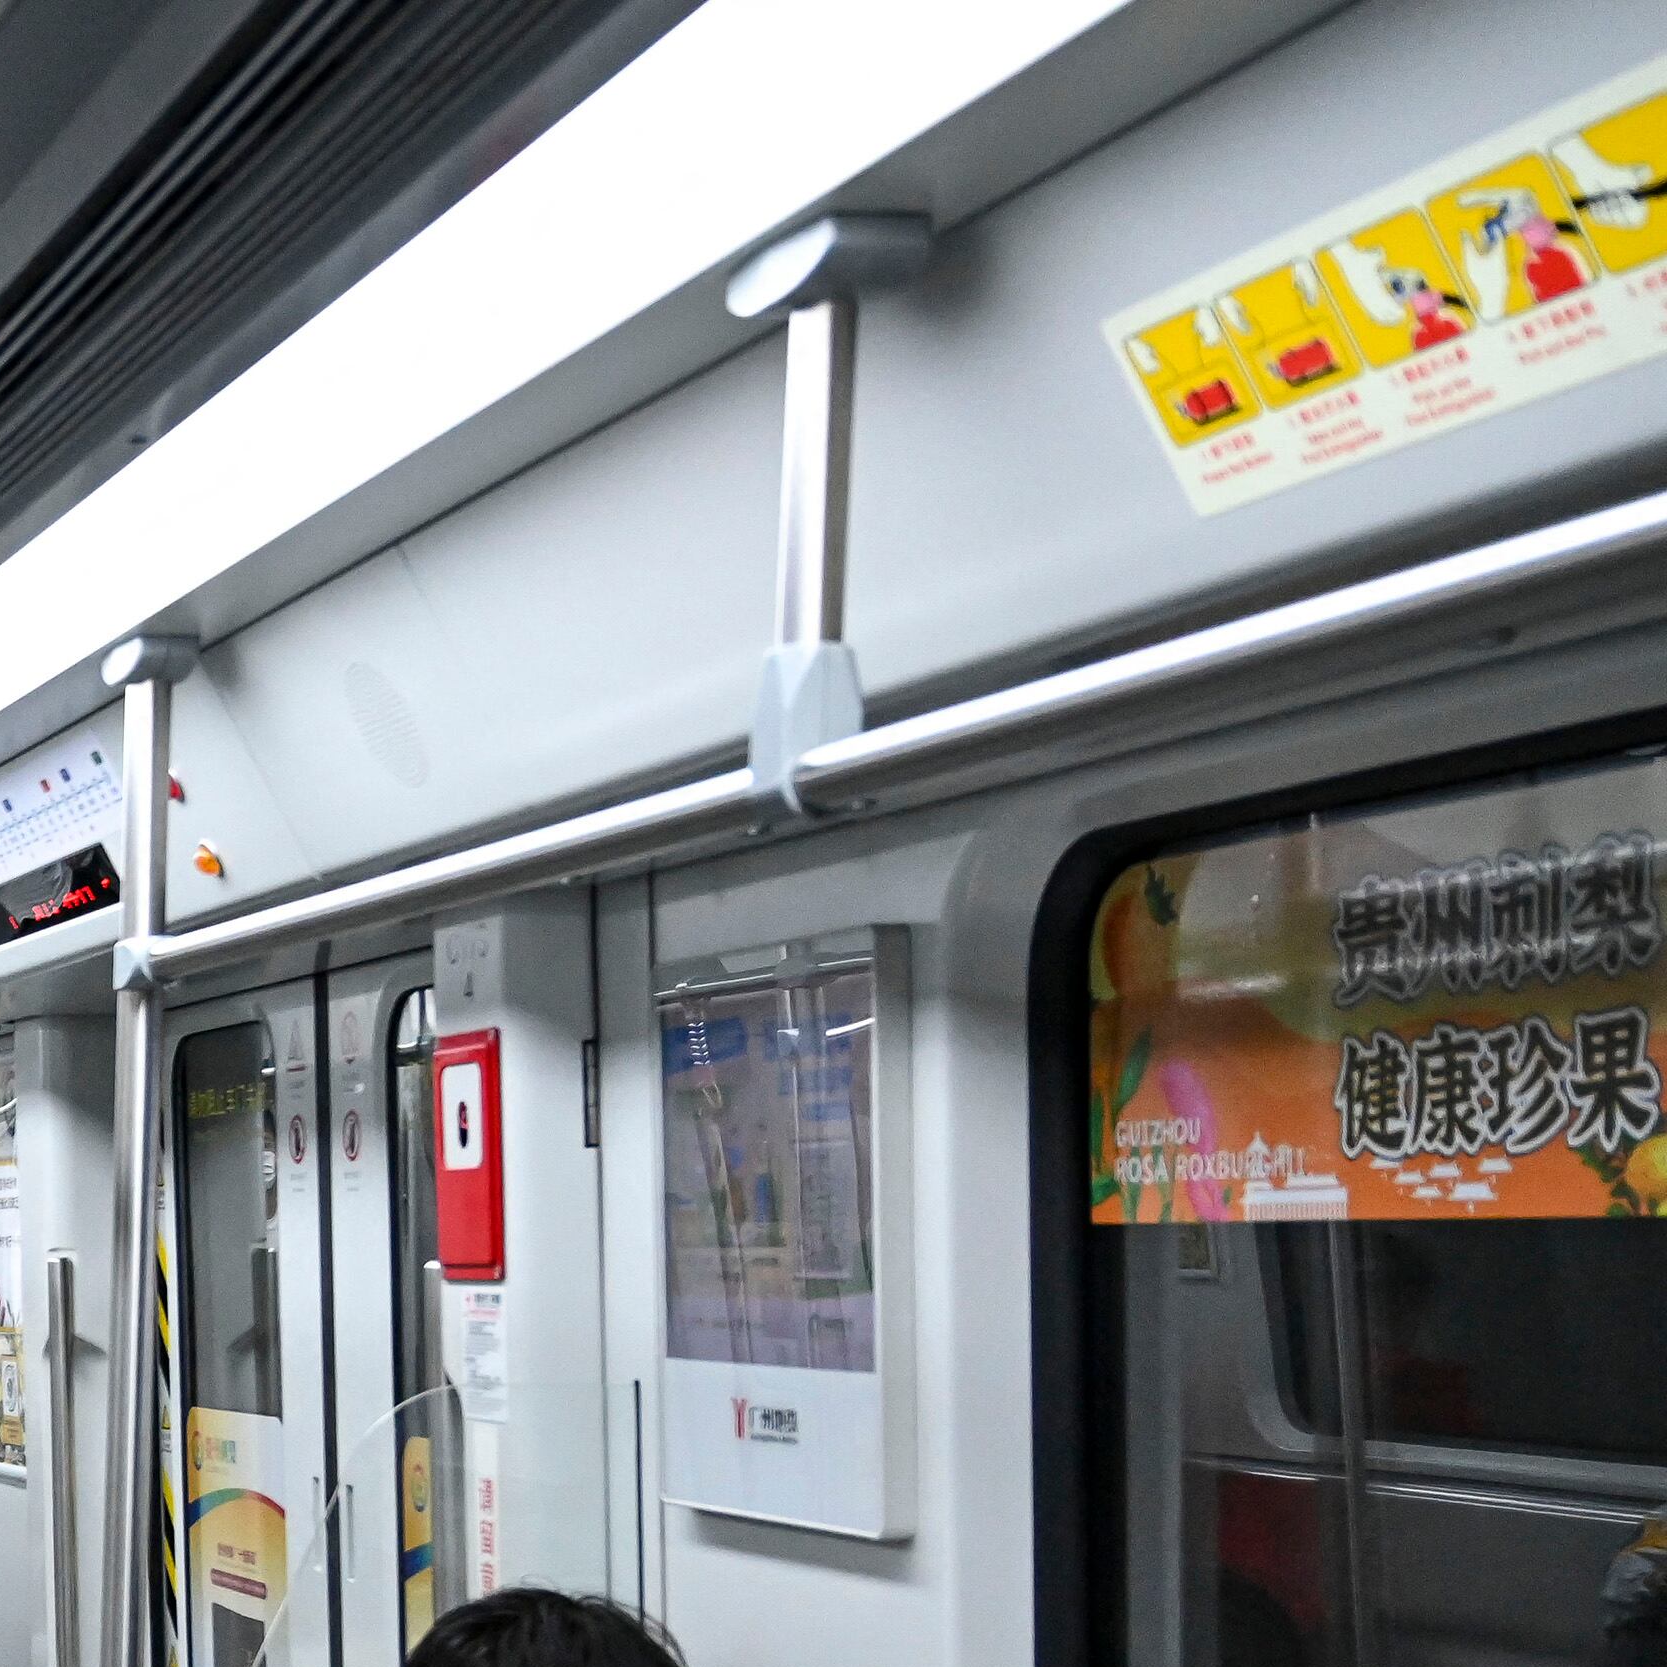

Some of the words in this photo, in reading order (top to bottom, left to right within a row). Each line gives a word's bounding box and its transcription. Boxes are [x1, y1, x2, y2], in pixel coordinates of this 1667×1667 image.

[1335, 832, 1662, 1006] 贵州刺梨
[1335, 1007, 1661, 1158] 健康珍果
[1115, 1117, 1202, 1147] GUIZHOU
[1115, 1153, 1170, 1184] ROSA
